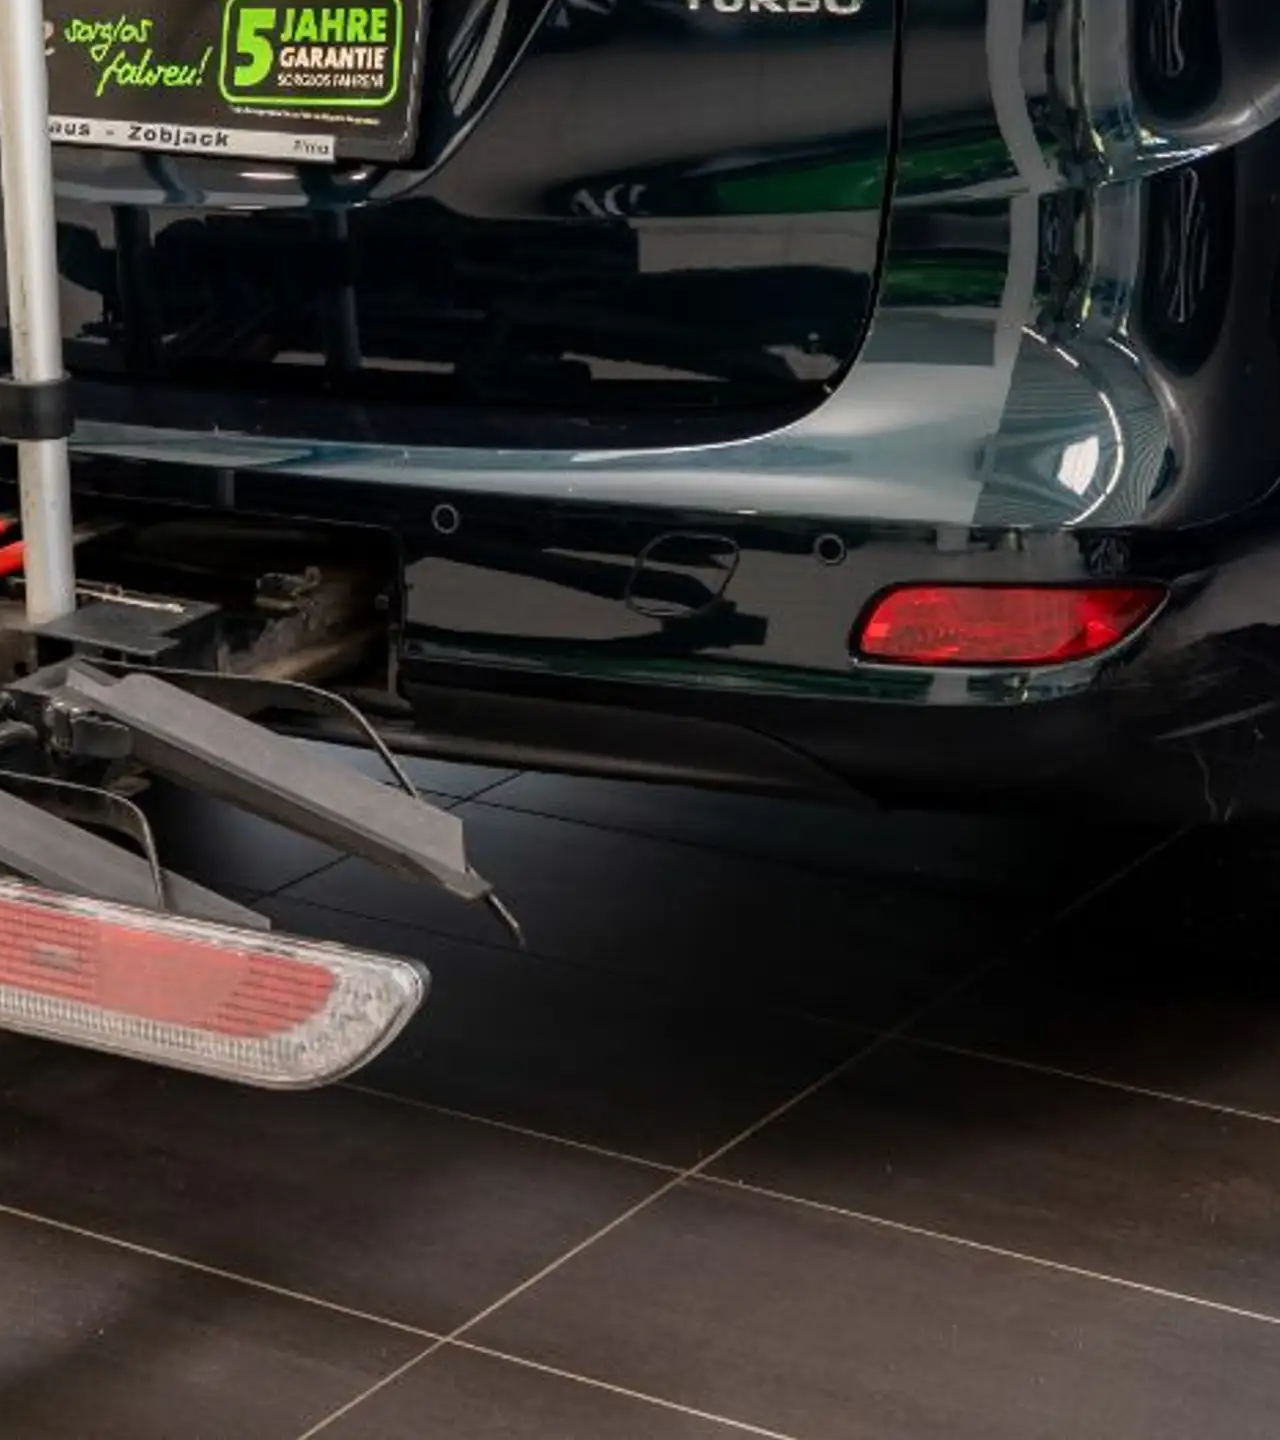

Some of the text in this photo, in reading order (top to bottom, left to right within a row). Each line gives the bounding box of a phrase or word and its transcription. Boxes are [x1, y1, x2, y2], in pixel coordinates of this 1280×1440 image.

[234, 8, 388, 86] 5 JAHRE
[279, 46, 389, 70] GARANTIE
[127, 125, 228, 147] Zobjack
